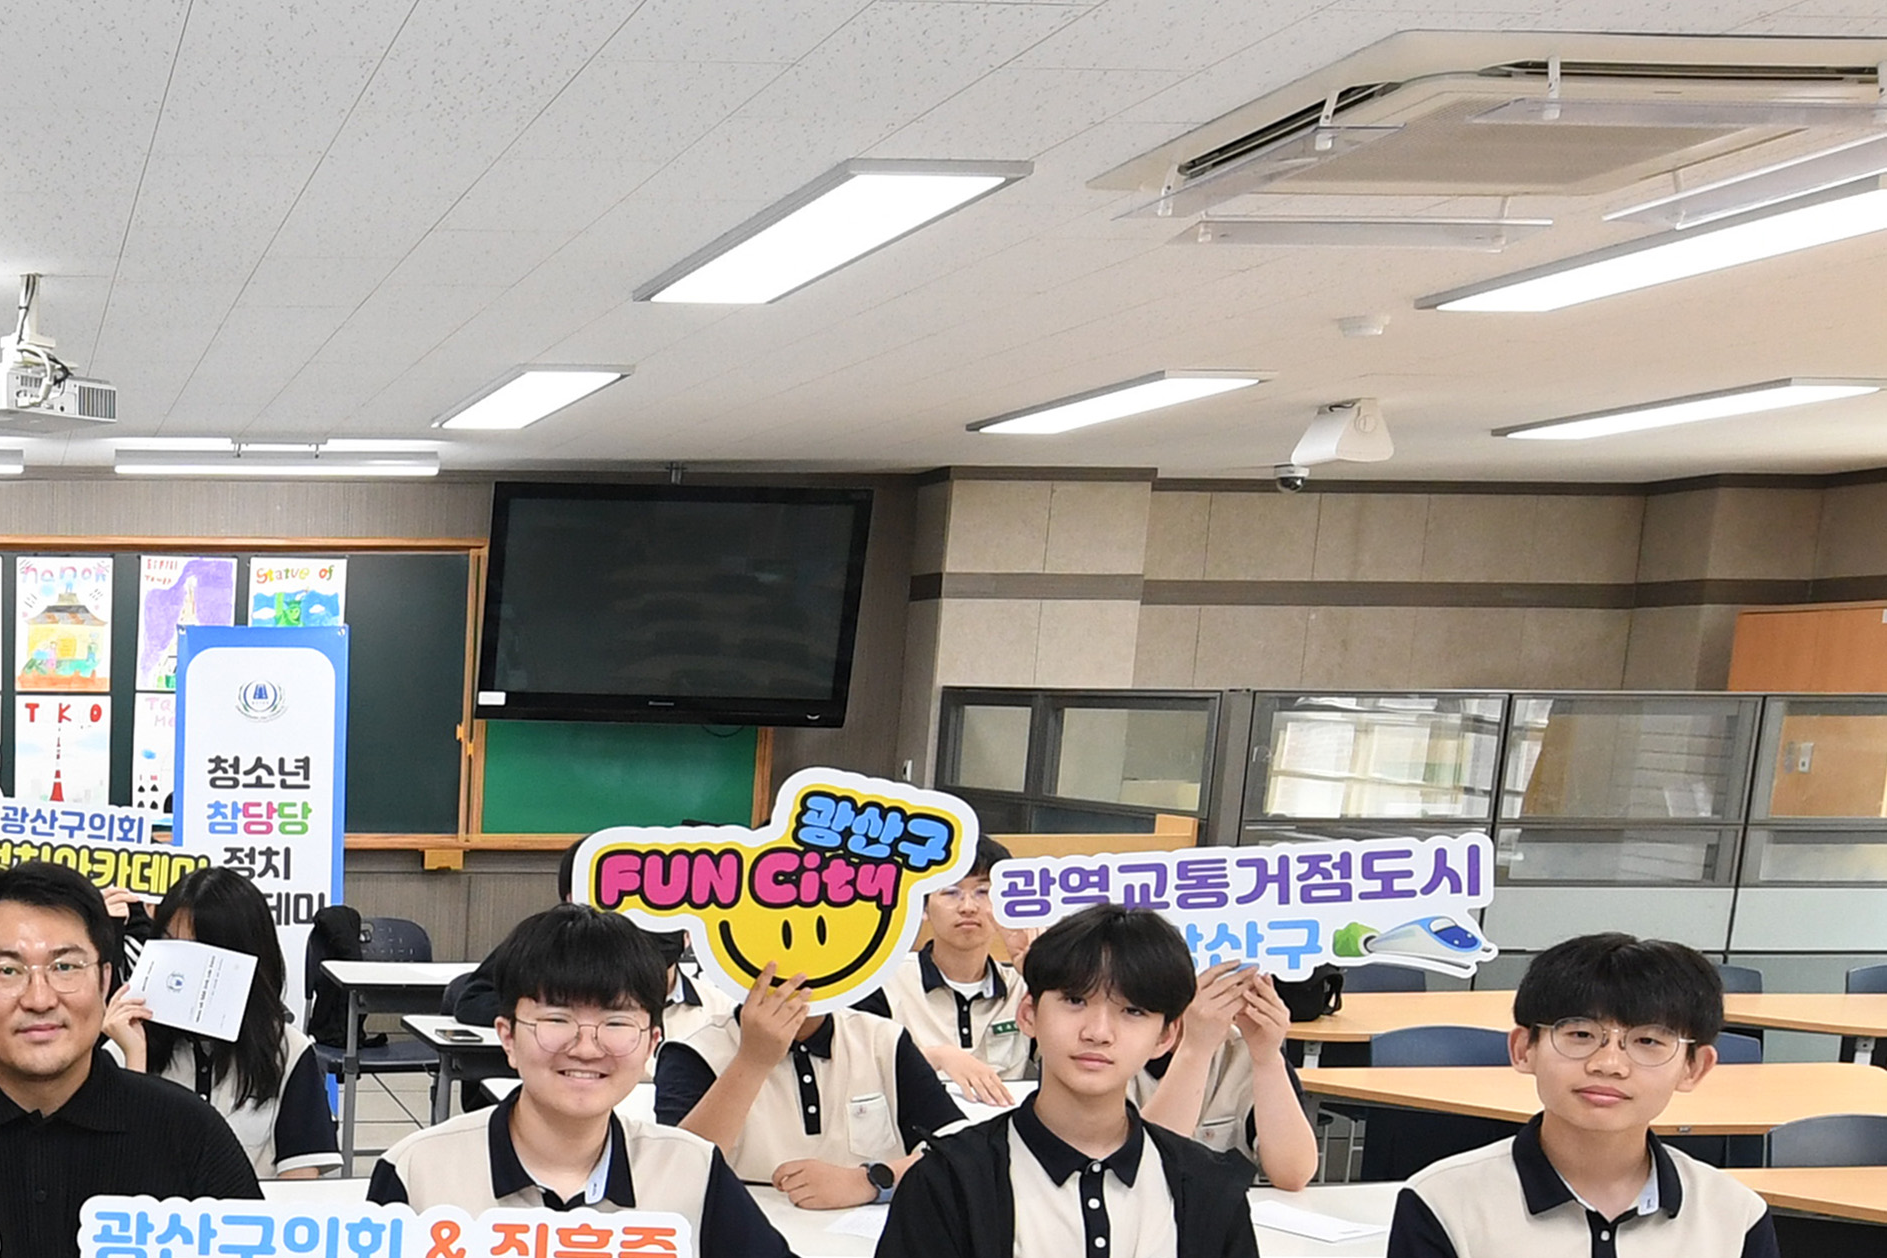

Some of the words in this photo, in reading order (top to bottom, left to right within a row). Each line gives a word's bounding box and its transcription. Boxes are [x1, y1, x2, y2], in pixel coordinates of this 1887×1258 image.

[256, 567, 310, 584] Statue
[318, 565, 335, 580] of
[207, 755, 311, 790] 청소년
[0, 806, 144, 845] 광산구의회
[207, 800, 312, 835] 참당당
[799, 795, 950, 868] 광산구
[223, 847, 291, 880] 정치
[600, 852, 740, 906] FUN
[753, 850, 898, 907] City
[1000, 843, 1481, 919] 광역교통거점도시
[1179, 919, 1323, 972] 산구
